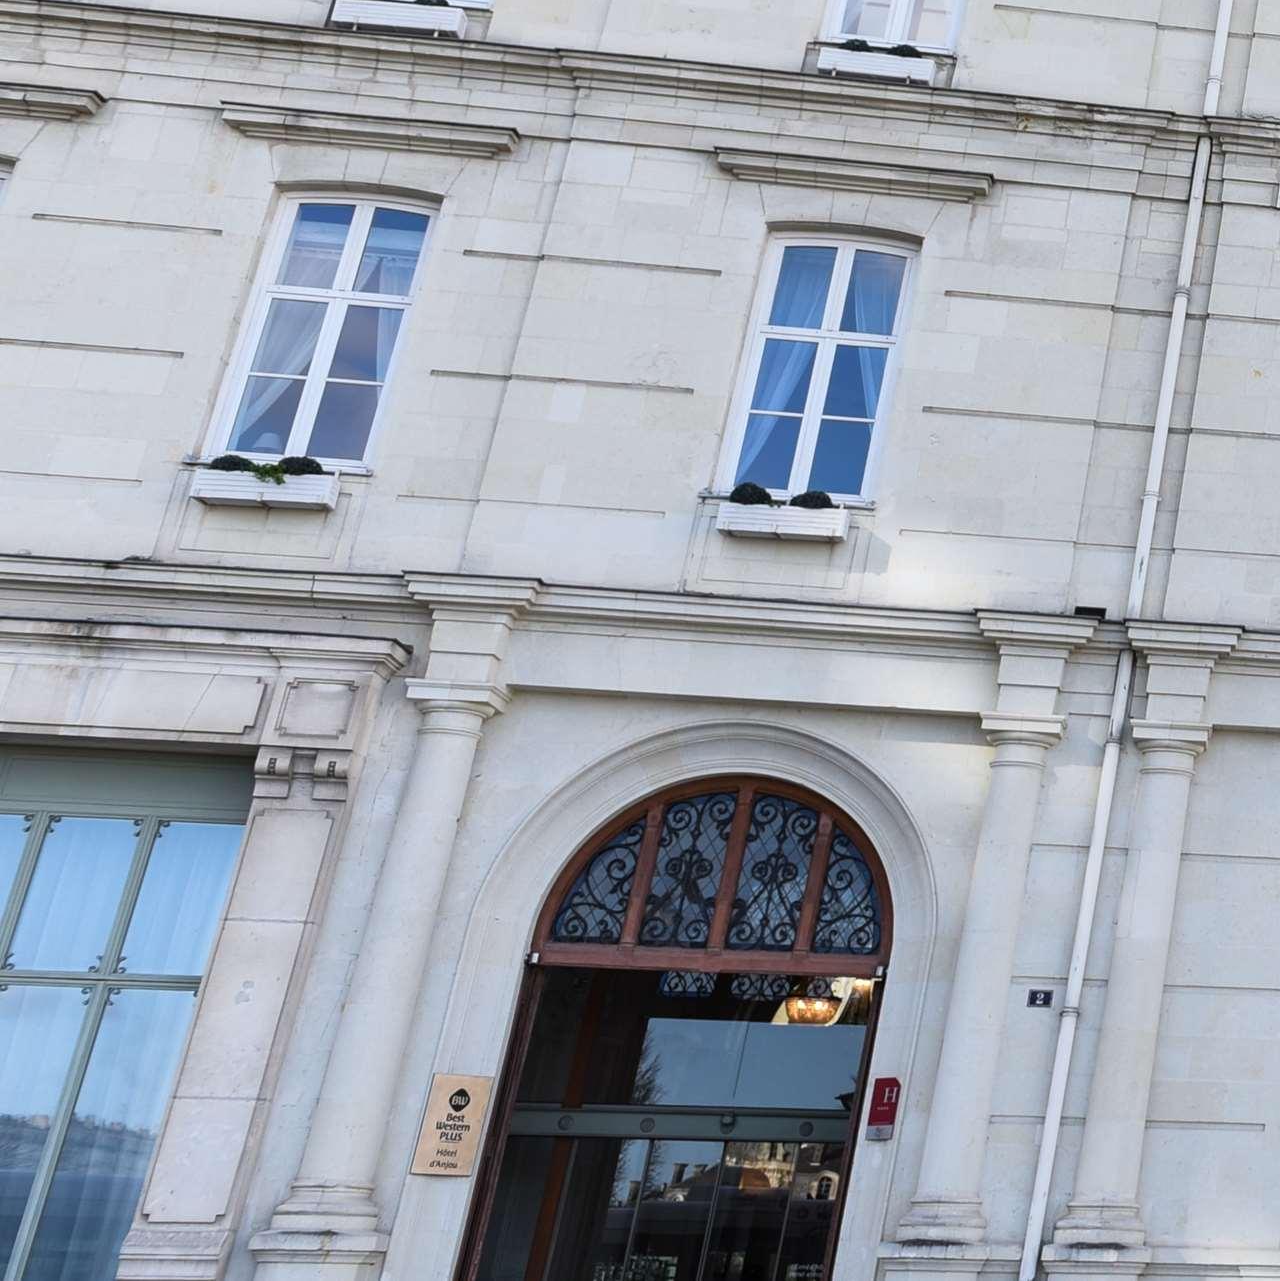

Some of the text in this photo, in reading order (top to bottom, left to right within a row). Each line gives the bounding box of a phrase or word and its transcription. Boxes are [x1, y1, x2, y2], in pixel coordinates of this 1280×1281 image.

[883, 1087, 898, 1103] H
[445, 1113, 465, 1123] Best
[436, 1121, 470, 1132] Western
[439, 1132, 463, 1142] PLUS
